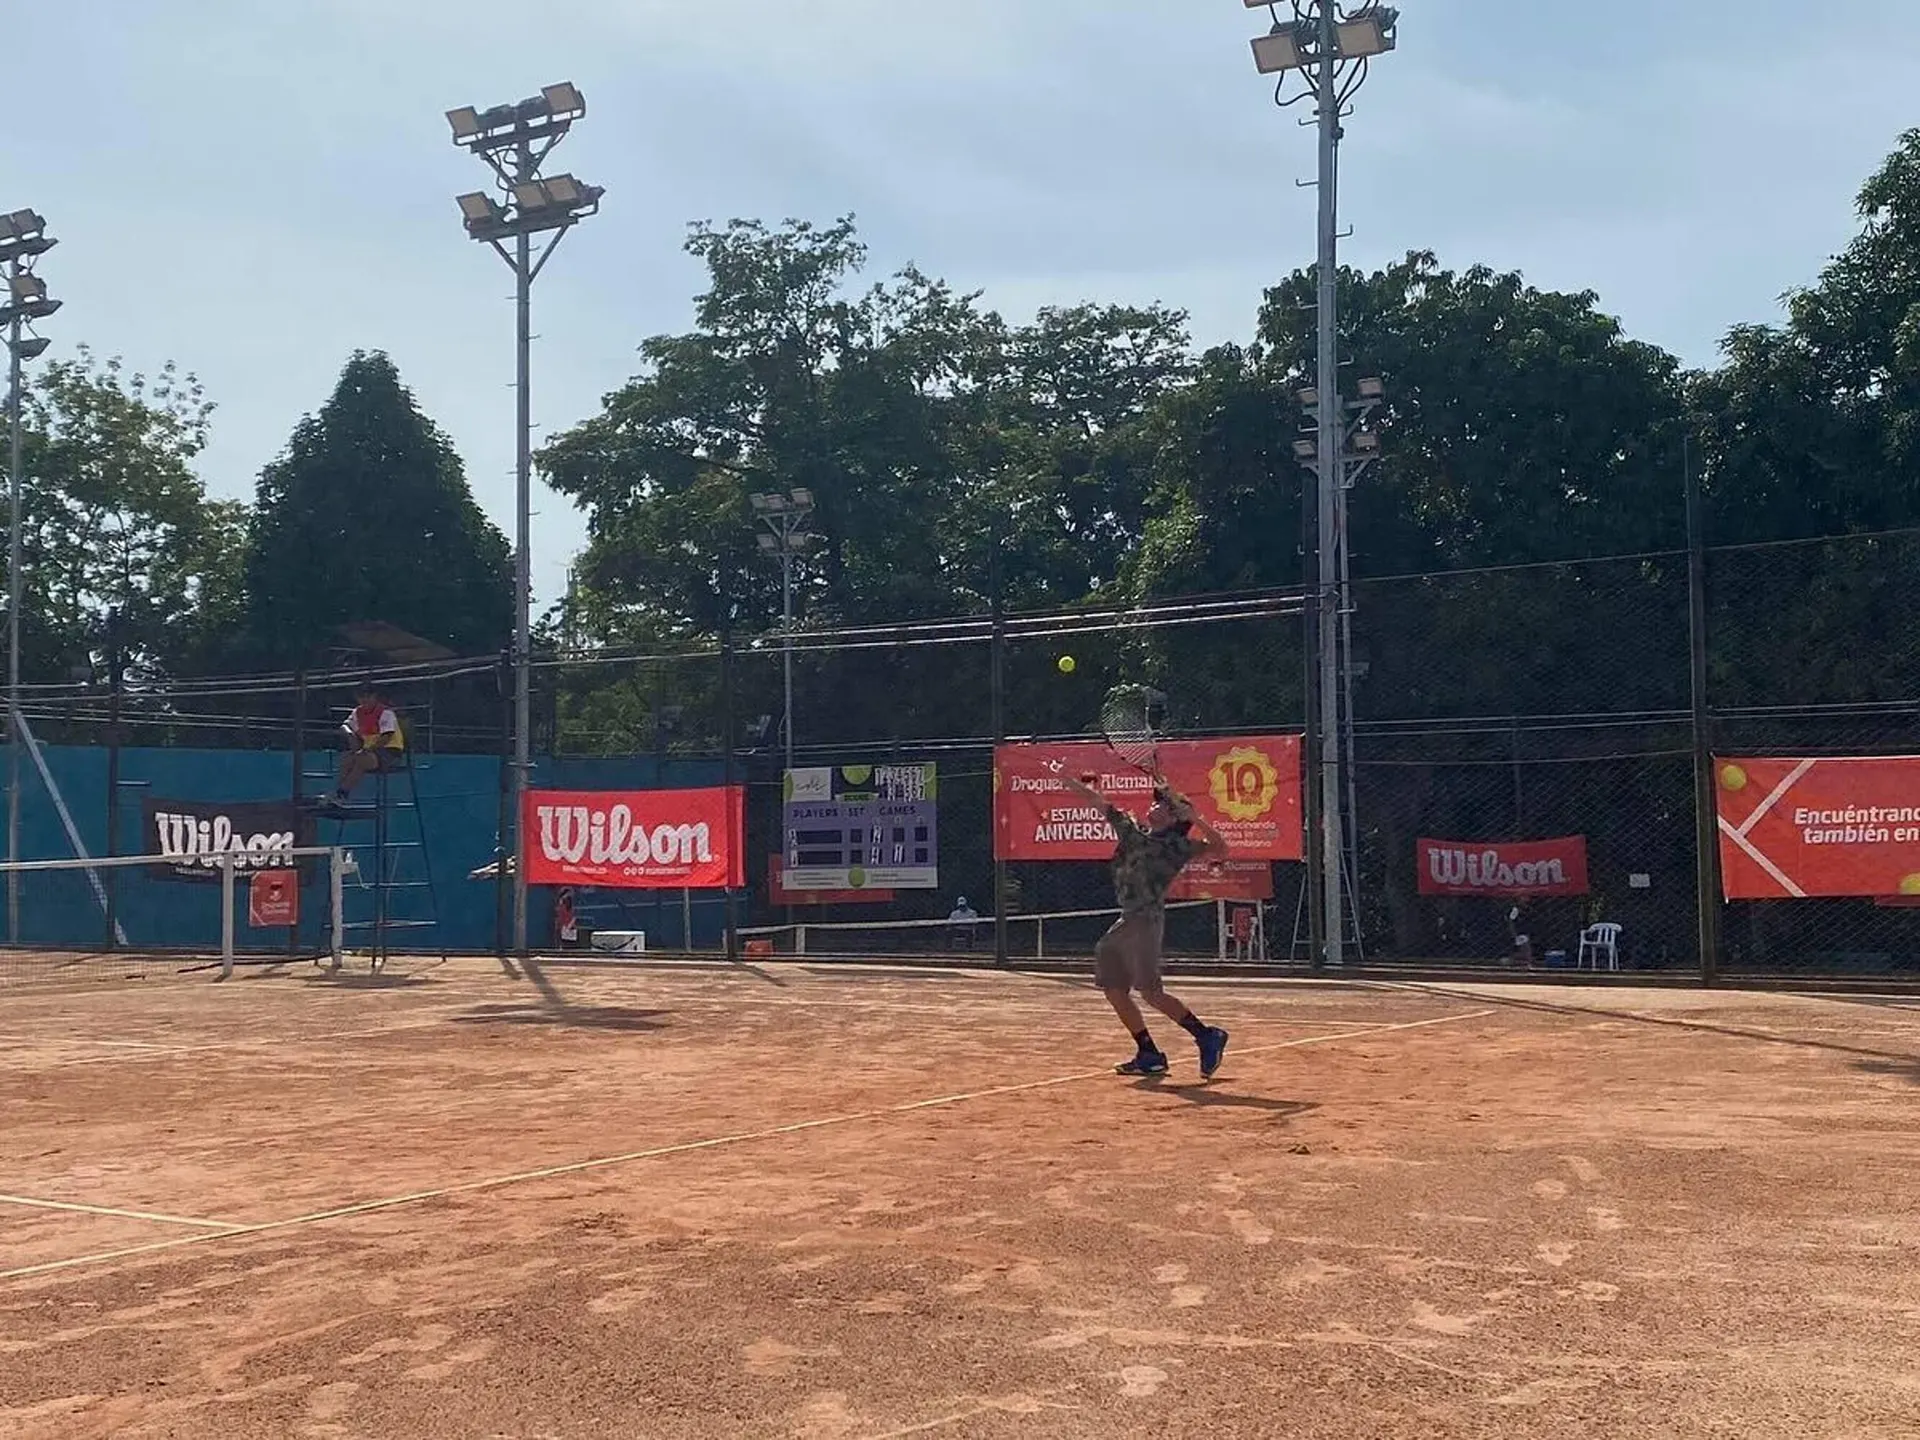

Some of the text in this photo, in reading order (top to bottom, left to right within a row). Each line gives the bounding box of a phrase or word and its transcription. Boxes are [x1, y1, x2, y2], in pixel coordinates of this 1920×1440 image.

[1221, 762, 1263, 802] 10
[792, 805, 916, 819] PLAYERS SET GAMES
[155, 812, 294, 868] Wilson
[537, 804, 713, 864] Wilson
[1035, 823, 1119, 842] ANIVERSA
[1803, 824, 1889, 844] también
[1428, 848, 1567, 887] Wilson
